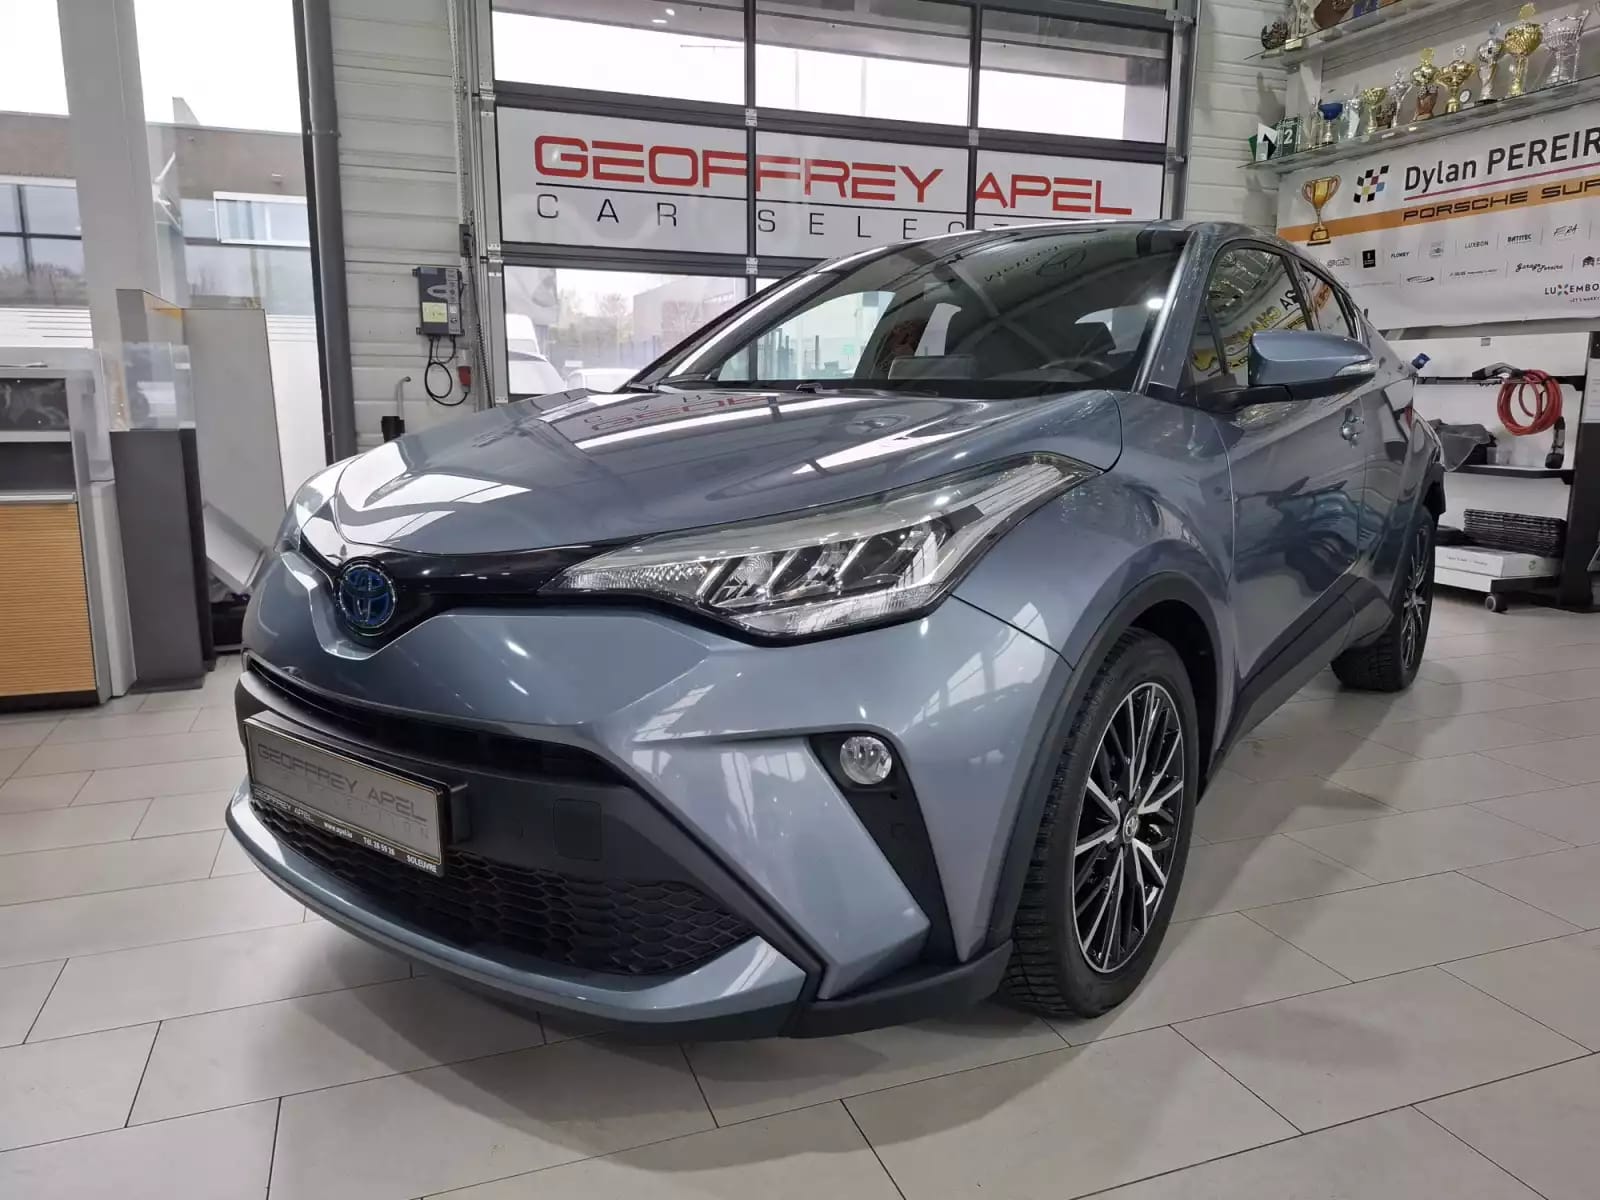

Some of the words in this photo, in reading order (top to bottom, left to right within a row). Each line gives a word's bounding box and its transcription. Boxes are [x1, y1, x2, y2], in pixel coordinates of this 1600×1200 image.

[534, 134, 944, 202] GEOFFREY
[974, 171, 1132, 215] APEL
[1405, 160, 1477, 193] Dylan
[537, 192, 678, 227] CAR
[1403, 190, 1529, 222] PORSCHE
[257, 743, 358, 793] GEOFFREY
[368, 787, 428, 822] APEL
